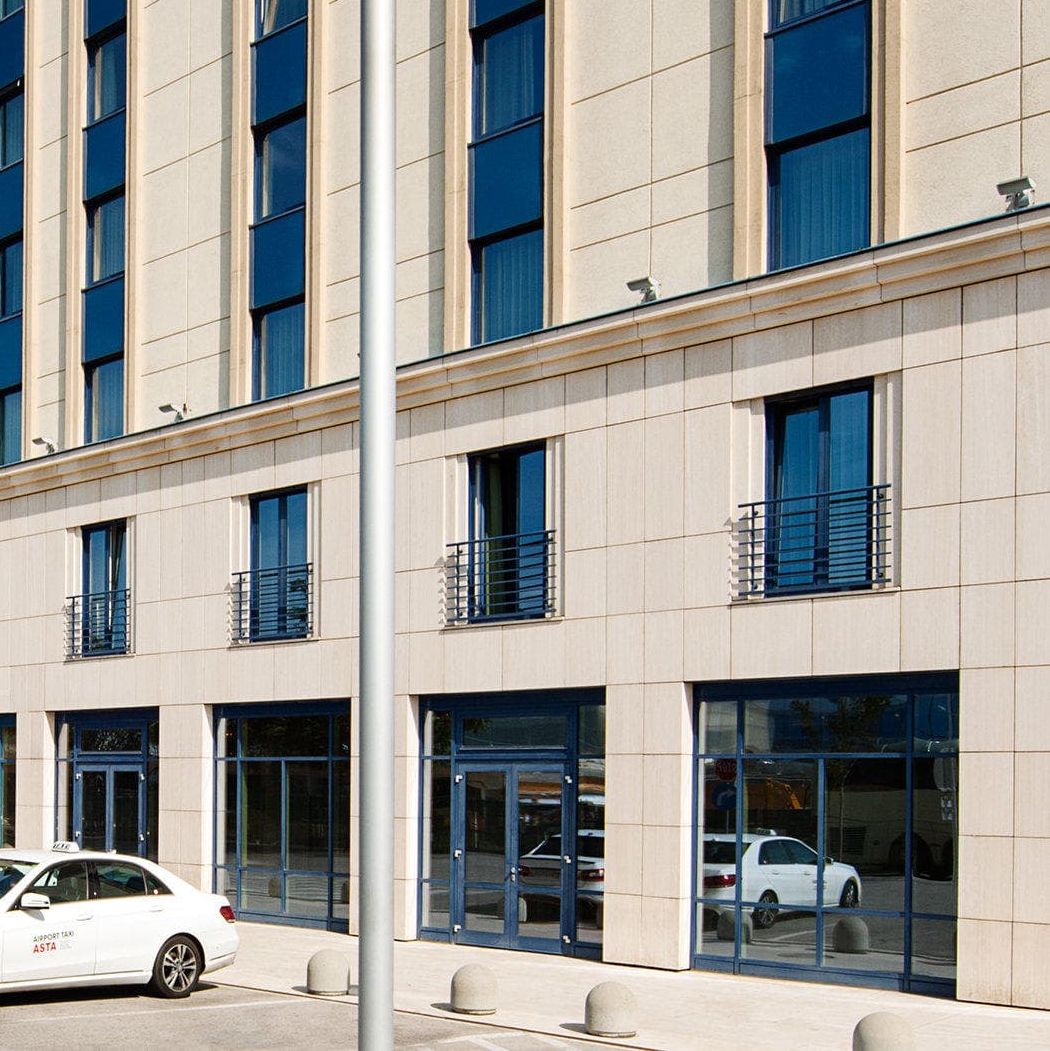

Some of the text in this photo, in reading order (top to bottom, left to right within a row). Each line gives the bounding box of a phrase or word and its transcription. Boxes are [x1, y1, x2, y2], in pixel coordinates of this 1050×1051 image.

[33, 931, 74, 942] AIRPORT TAXI
[33, 942, 56, 953] ASTA
